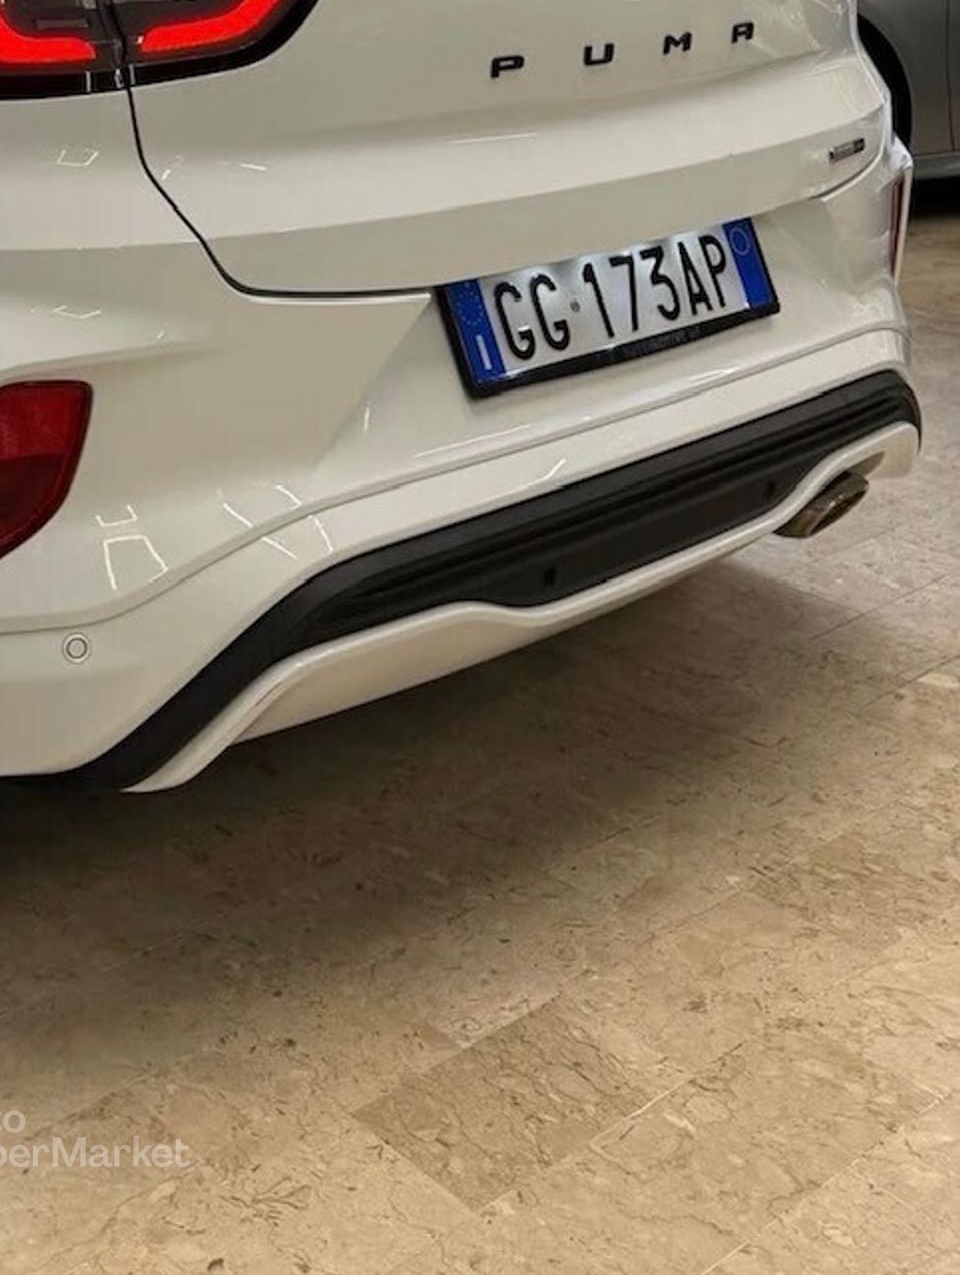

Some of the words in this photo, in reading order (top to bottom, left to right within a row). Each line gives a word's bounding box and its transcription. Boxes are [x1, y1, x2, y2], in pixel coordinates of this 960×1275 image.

[490, 22, 755, 78] PUMA
[494, 273, 570, 360] GG
[582, 234, 727, 338] 173AP
